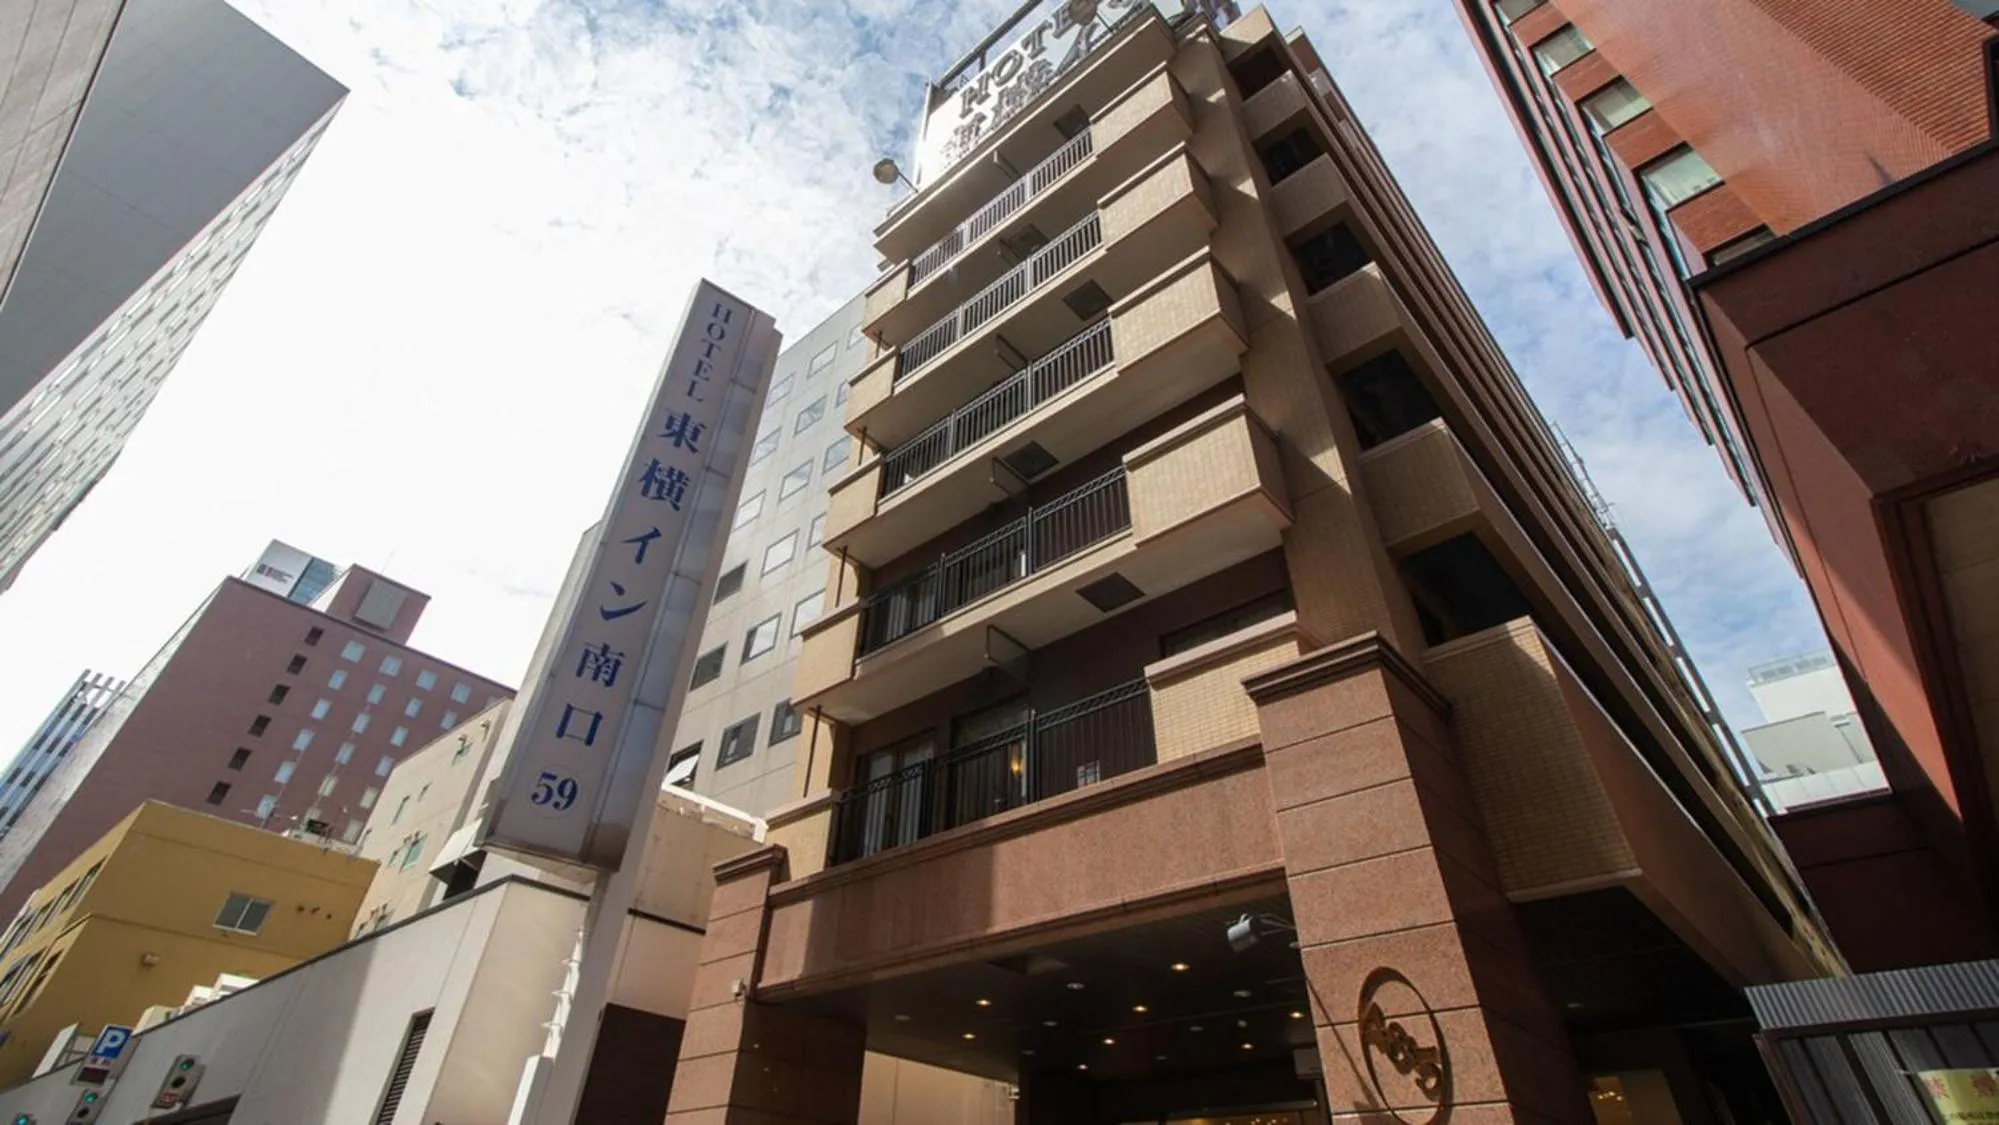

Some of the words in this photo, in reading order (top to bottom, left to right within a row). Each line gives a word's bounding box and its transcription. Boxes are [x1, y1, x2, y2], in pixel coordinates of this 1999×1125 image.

[686, 302, 733, 403] HOTEL
[555, 407, 707, 747] 東横イン南口
[531, 771, 578, 811] 59
[95, 1029, 126, 1053] P
